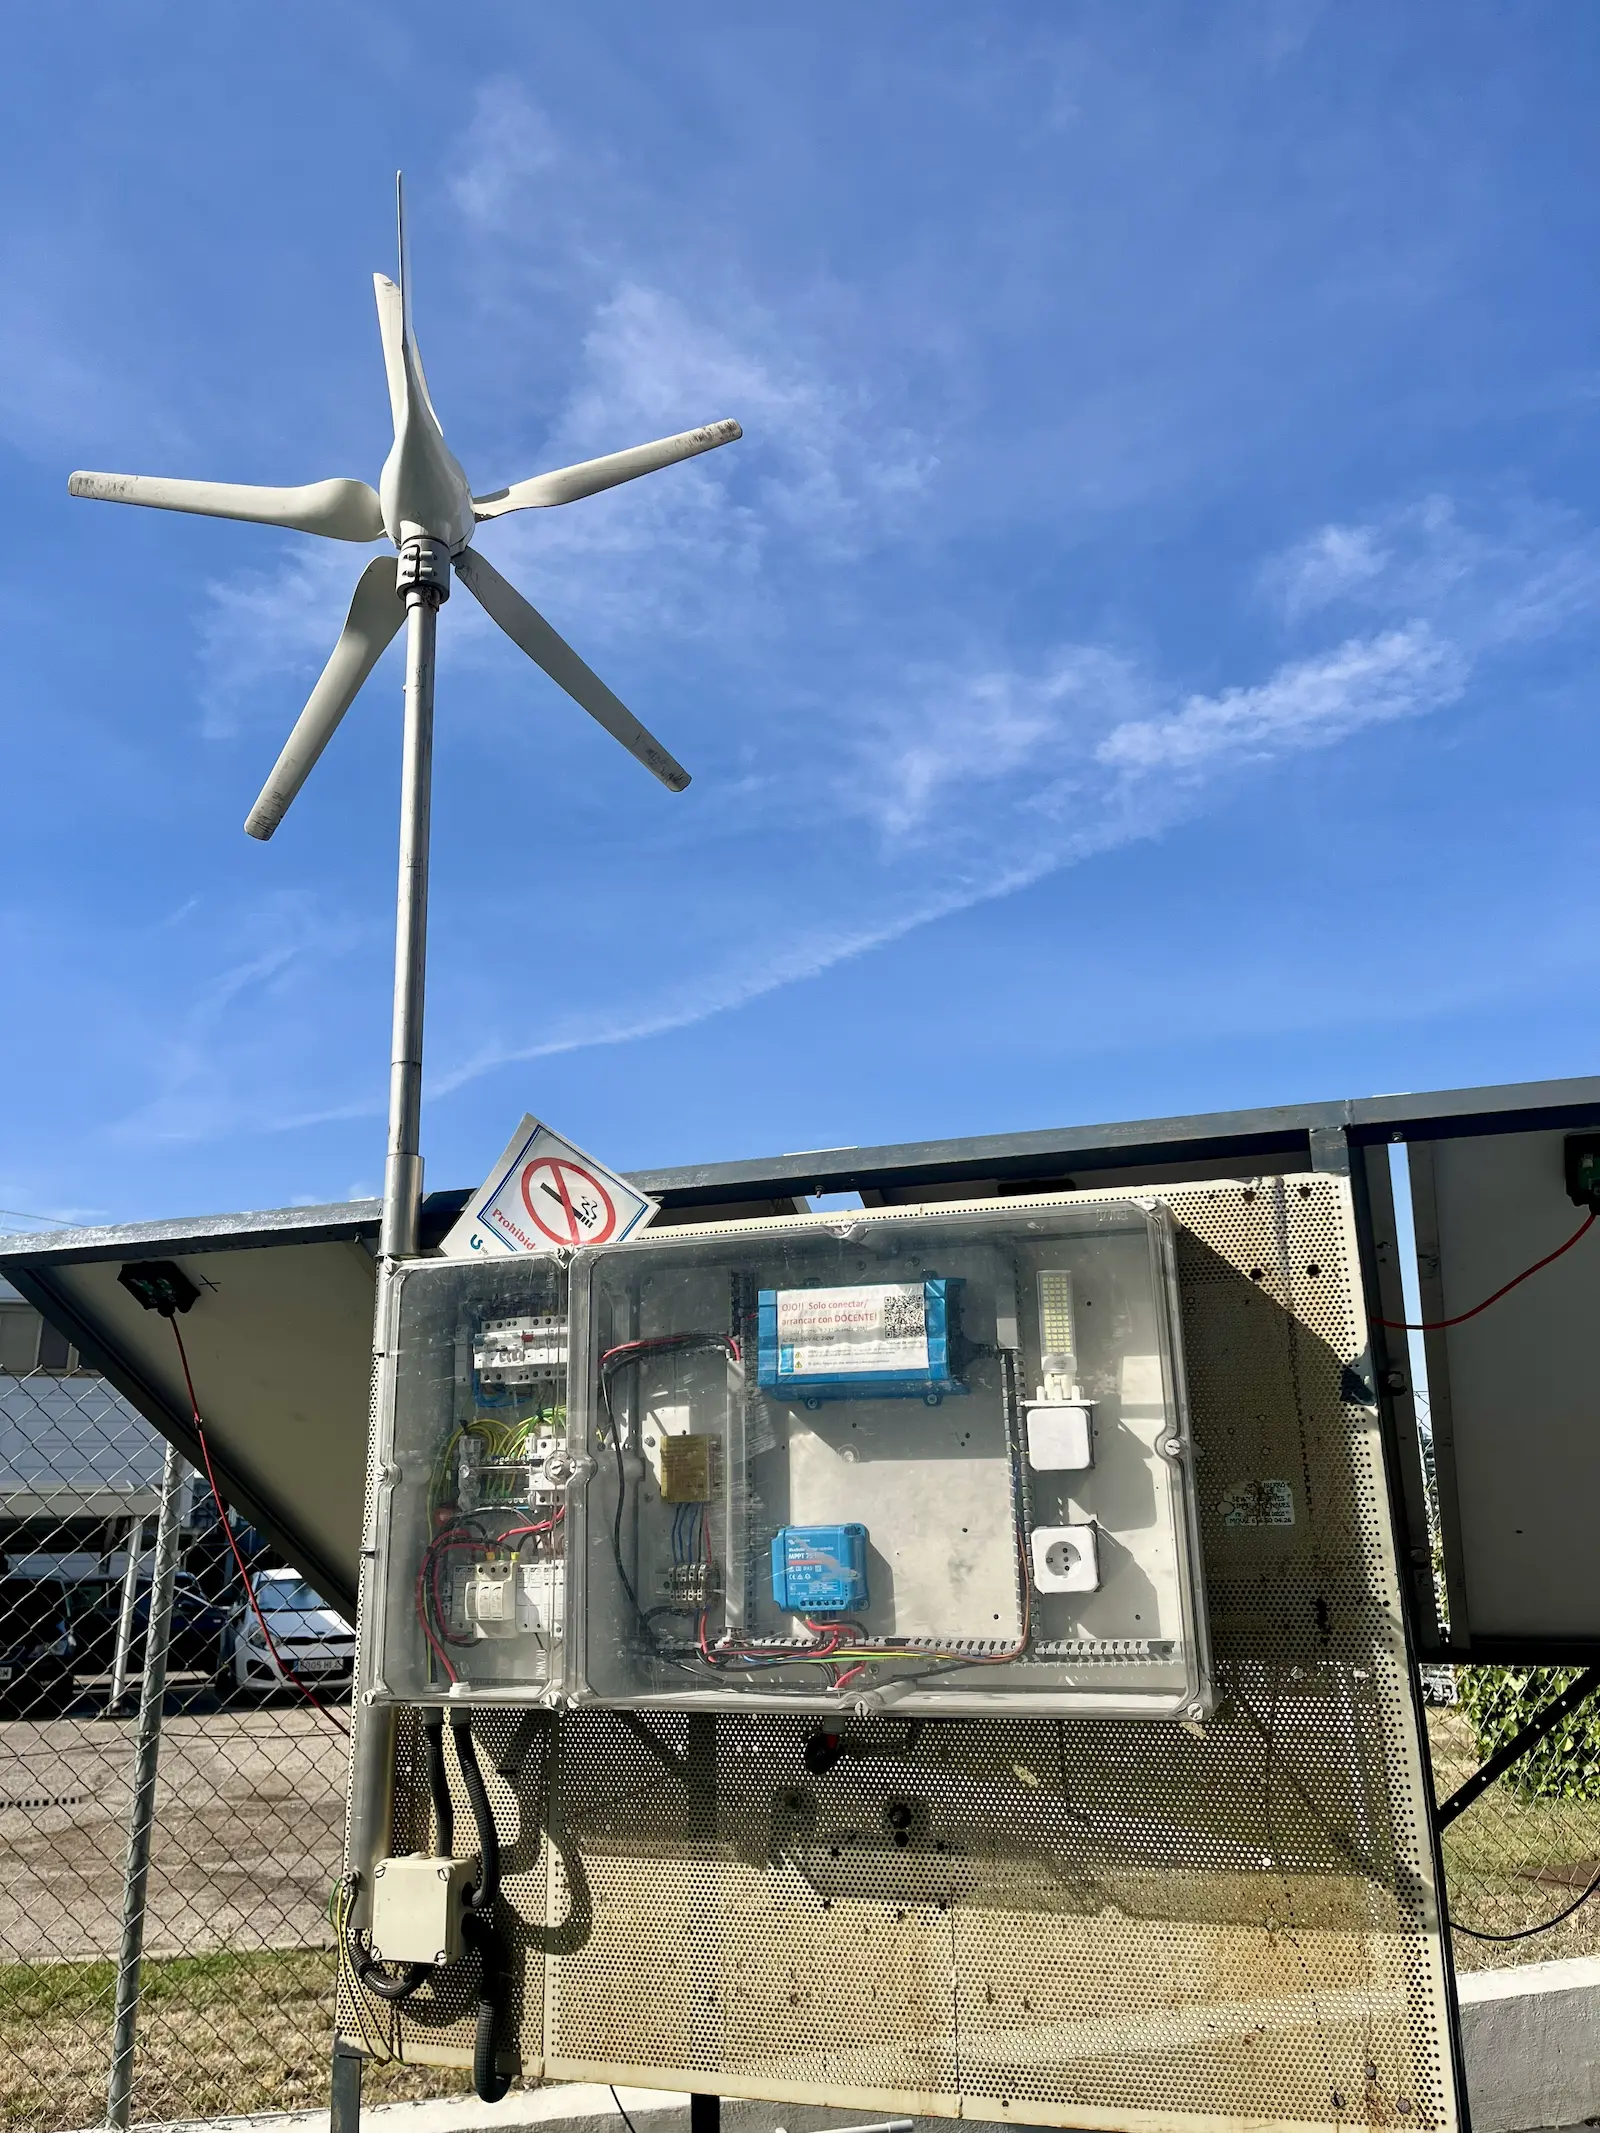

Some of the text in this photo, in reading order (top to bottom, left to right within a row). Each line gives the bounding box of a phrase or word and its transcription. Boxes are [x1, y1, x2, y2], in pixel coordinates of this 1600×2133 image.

[808, 1301, 827, 1310] Solo
[781, 1312, 877, 1326] arrancar con DOCENTE!
